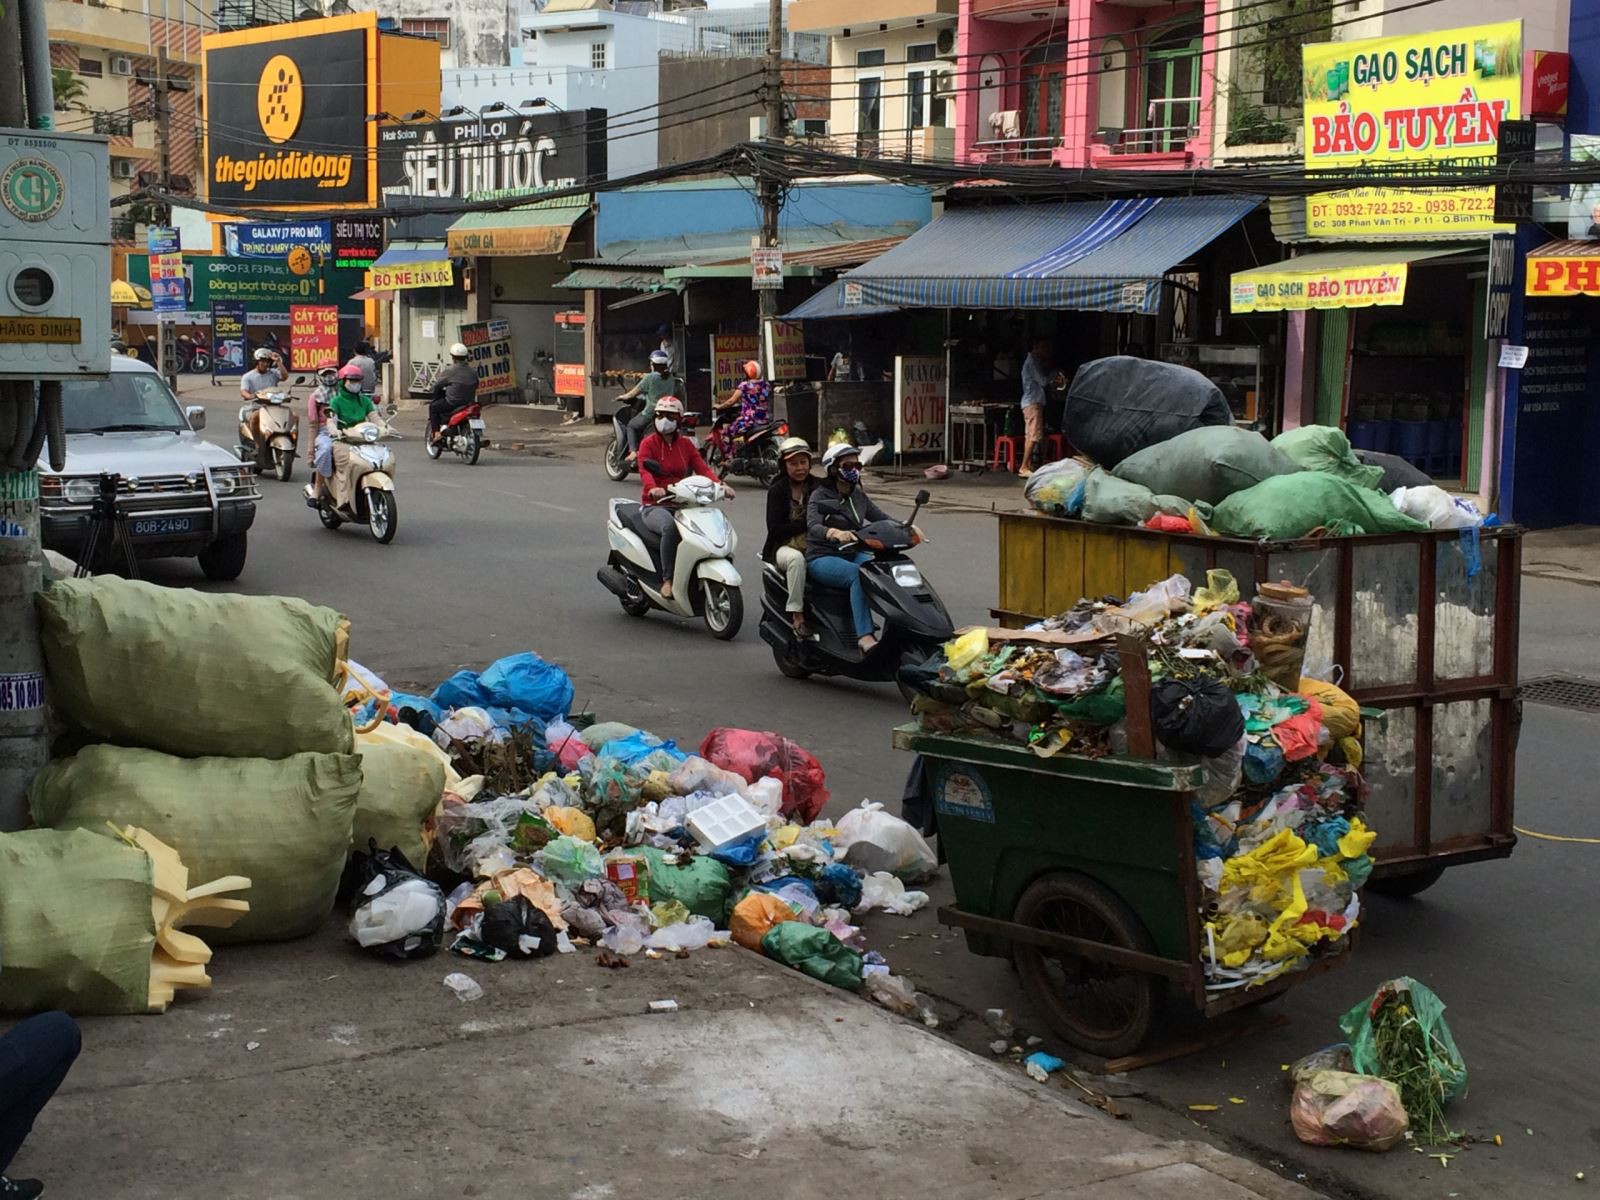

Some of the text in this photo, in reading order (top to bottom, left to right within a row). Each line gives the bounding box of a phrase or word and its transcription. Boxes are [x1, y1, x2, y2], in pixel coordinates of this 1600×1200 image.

[1353, 43, 1466, 89] GẠO SẠCH
[1312, 87, 1505, 154] BẢO TUYỀN
[383, 129, 417, 142] Hair Salon
[455, 125, 478, 140] PHI
[215, 151, 352, 191] thegioididong
[1336, 202, 1414, 217] 0932.722.252
[1425, 197, 1495, 212] 0938.722.2
[1332, 220, 1347, 228] 308
[1349, 219, 1371, 227] Phan
[251, 228, 281, 238] GALAXY
[290, 227, 306, 238] PRO
[265, 243, 289, 253] CAMRY
[208, 263, 236, 273] OPPO
[209, 278, 237, 292] Đồng
[316, 308, 338, 322] TÓC
[293, 325, 315, 335] NAM
[478, 375, 511, 389] 0.000đ
[909, 431, 944, 449] 19K
